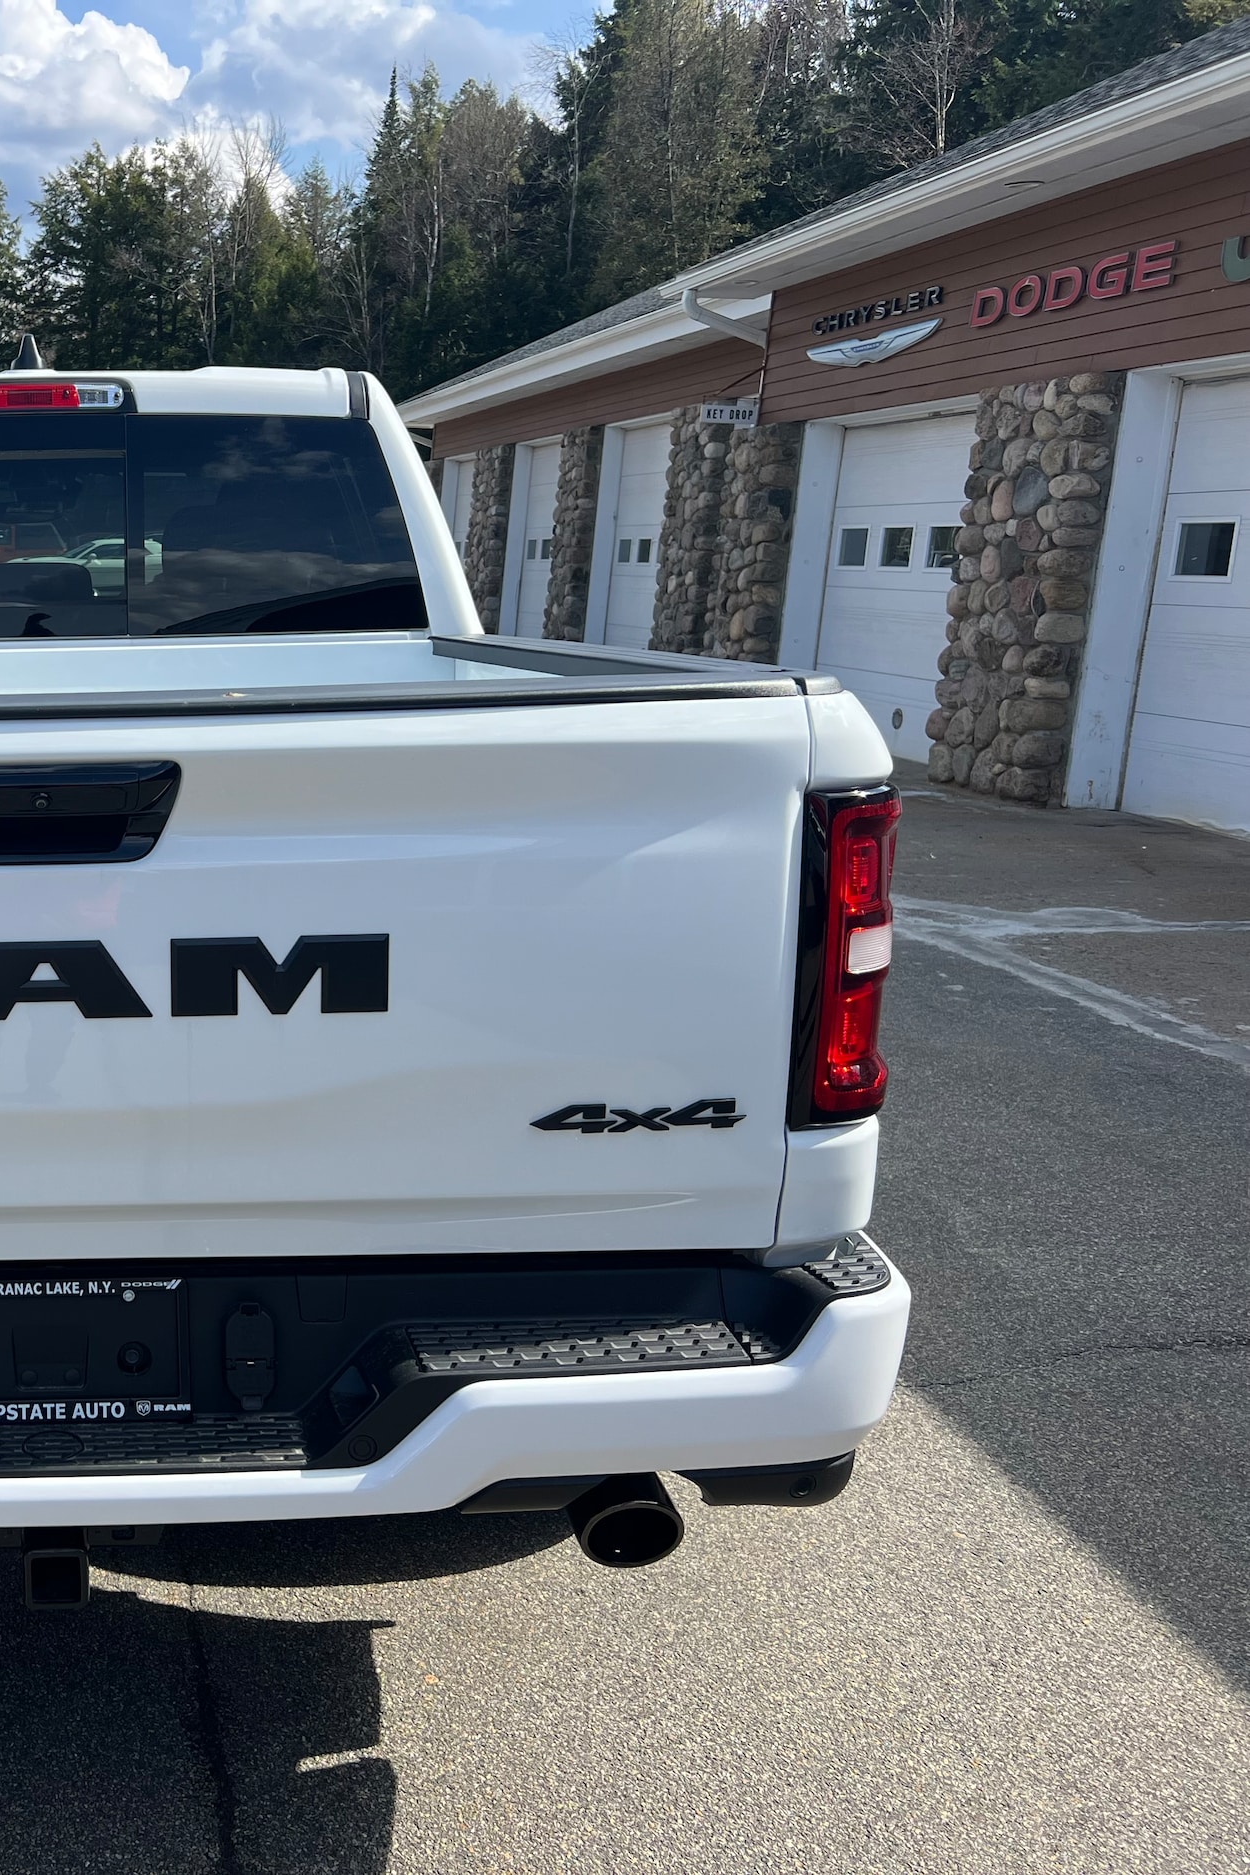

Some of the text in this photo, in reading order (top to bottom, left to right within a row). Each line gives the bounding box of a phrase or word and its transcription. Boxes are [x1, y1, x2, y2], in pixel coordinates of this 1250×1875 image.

[970, 241, 1178, 328] DODGE
[812, 285, 943, 336] CHRYSLER
[706, 409, 753, 420] KEY DROP
[529, 1098, 747, 1133] 4x4
[46, 1281, 84, 1296] LAKE,
[89, 1281, 115, 1294] N.Y.
[72, 1402, 125, 1419] AUTO
[154, 1403, 190, 1412] RAM
